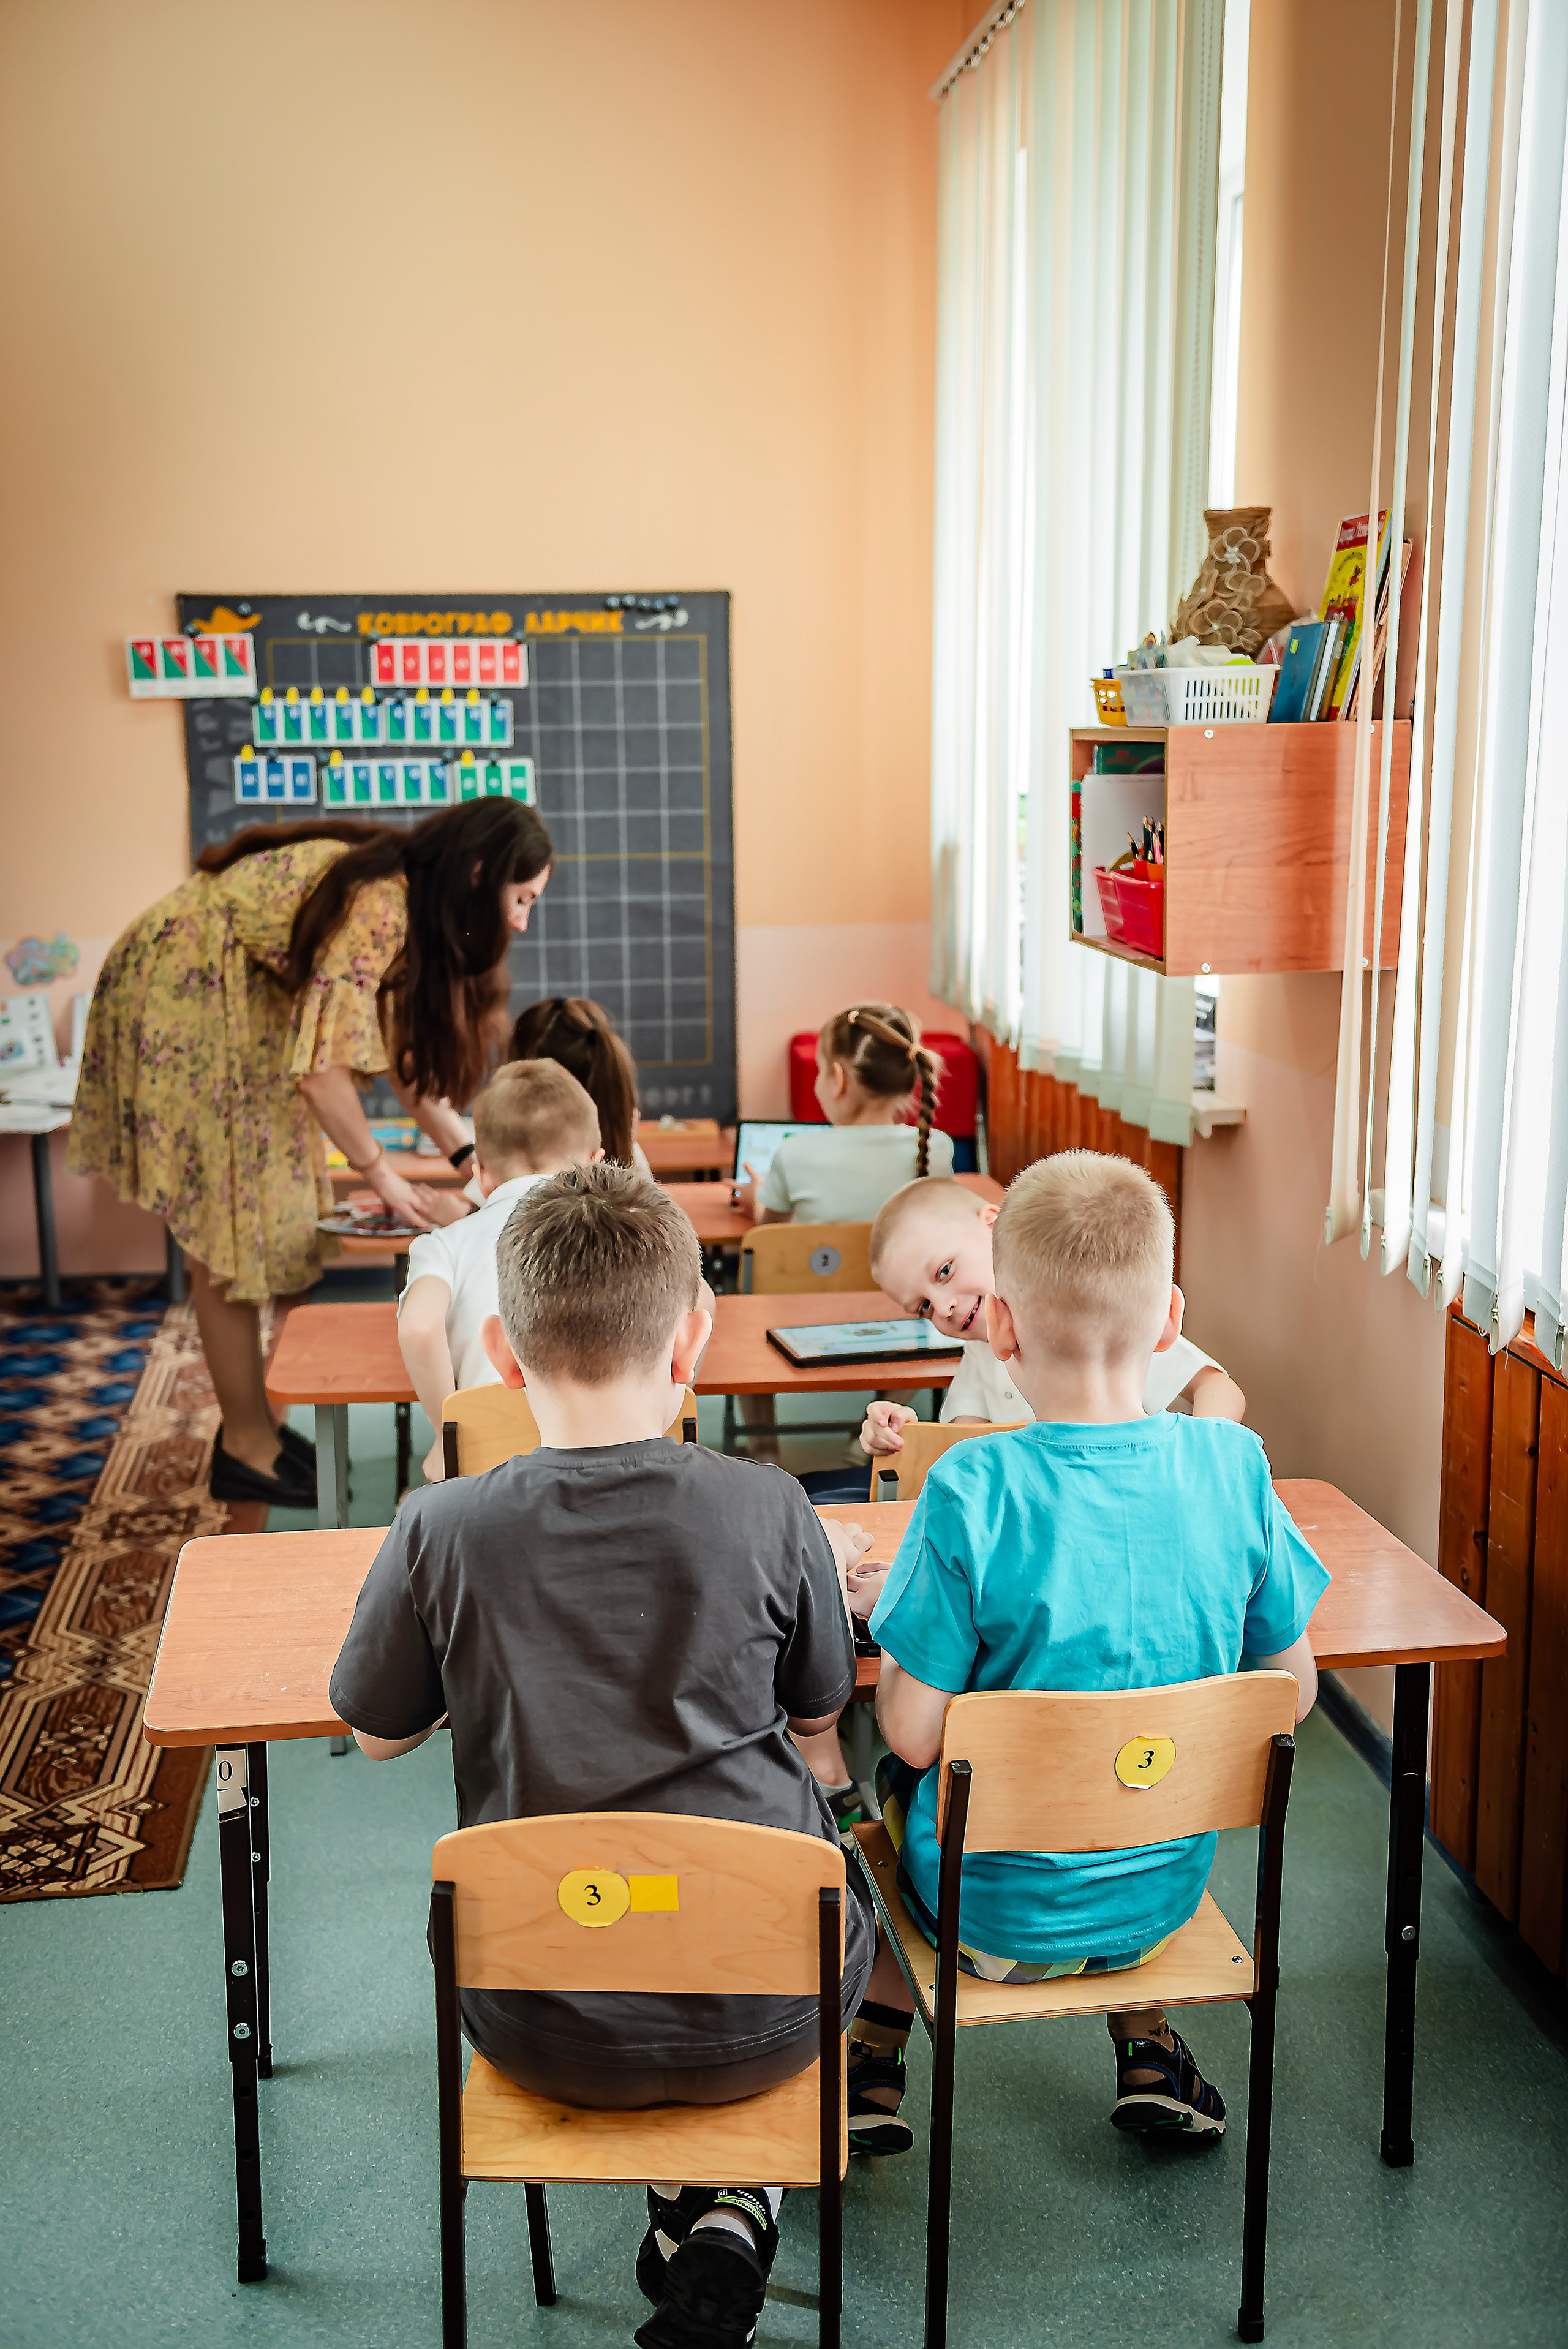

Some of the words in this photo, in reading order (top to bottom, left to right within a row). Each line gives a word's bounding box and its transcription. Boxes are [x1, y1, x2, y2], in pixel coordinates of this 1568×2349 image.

[1137, 1750, 1155, 1768] 3
[584, 1884, 601, 1906] 3
[734, 2200, 752, 2211] URBAN
